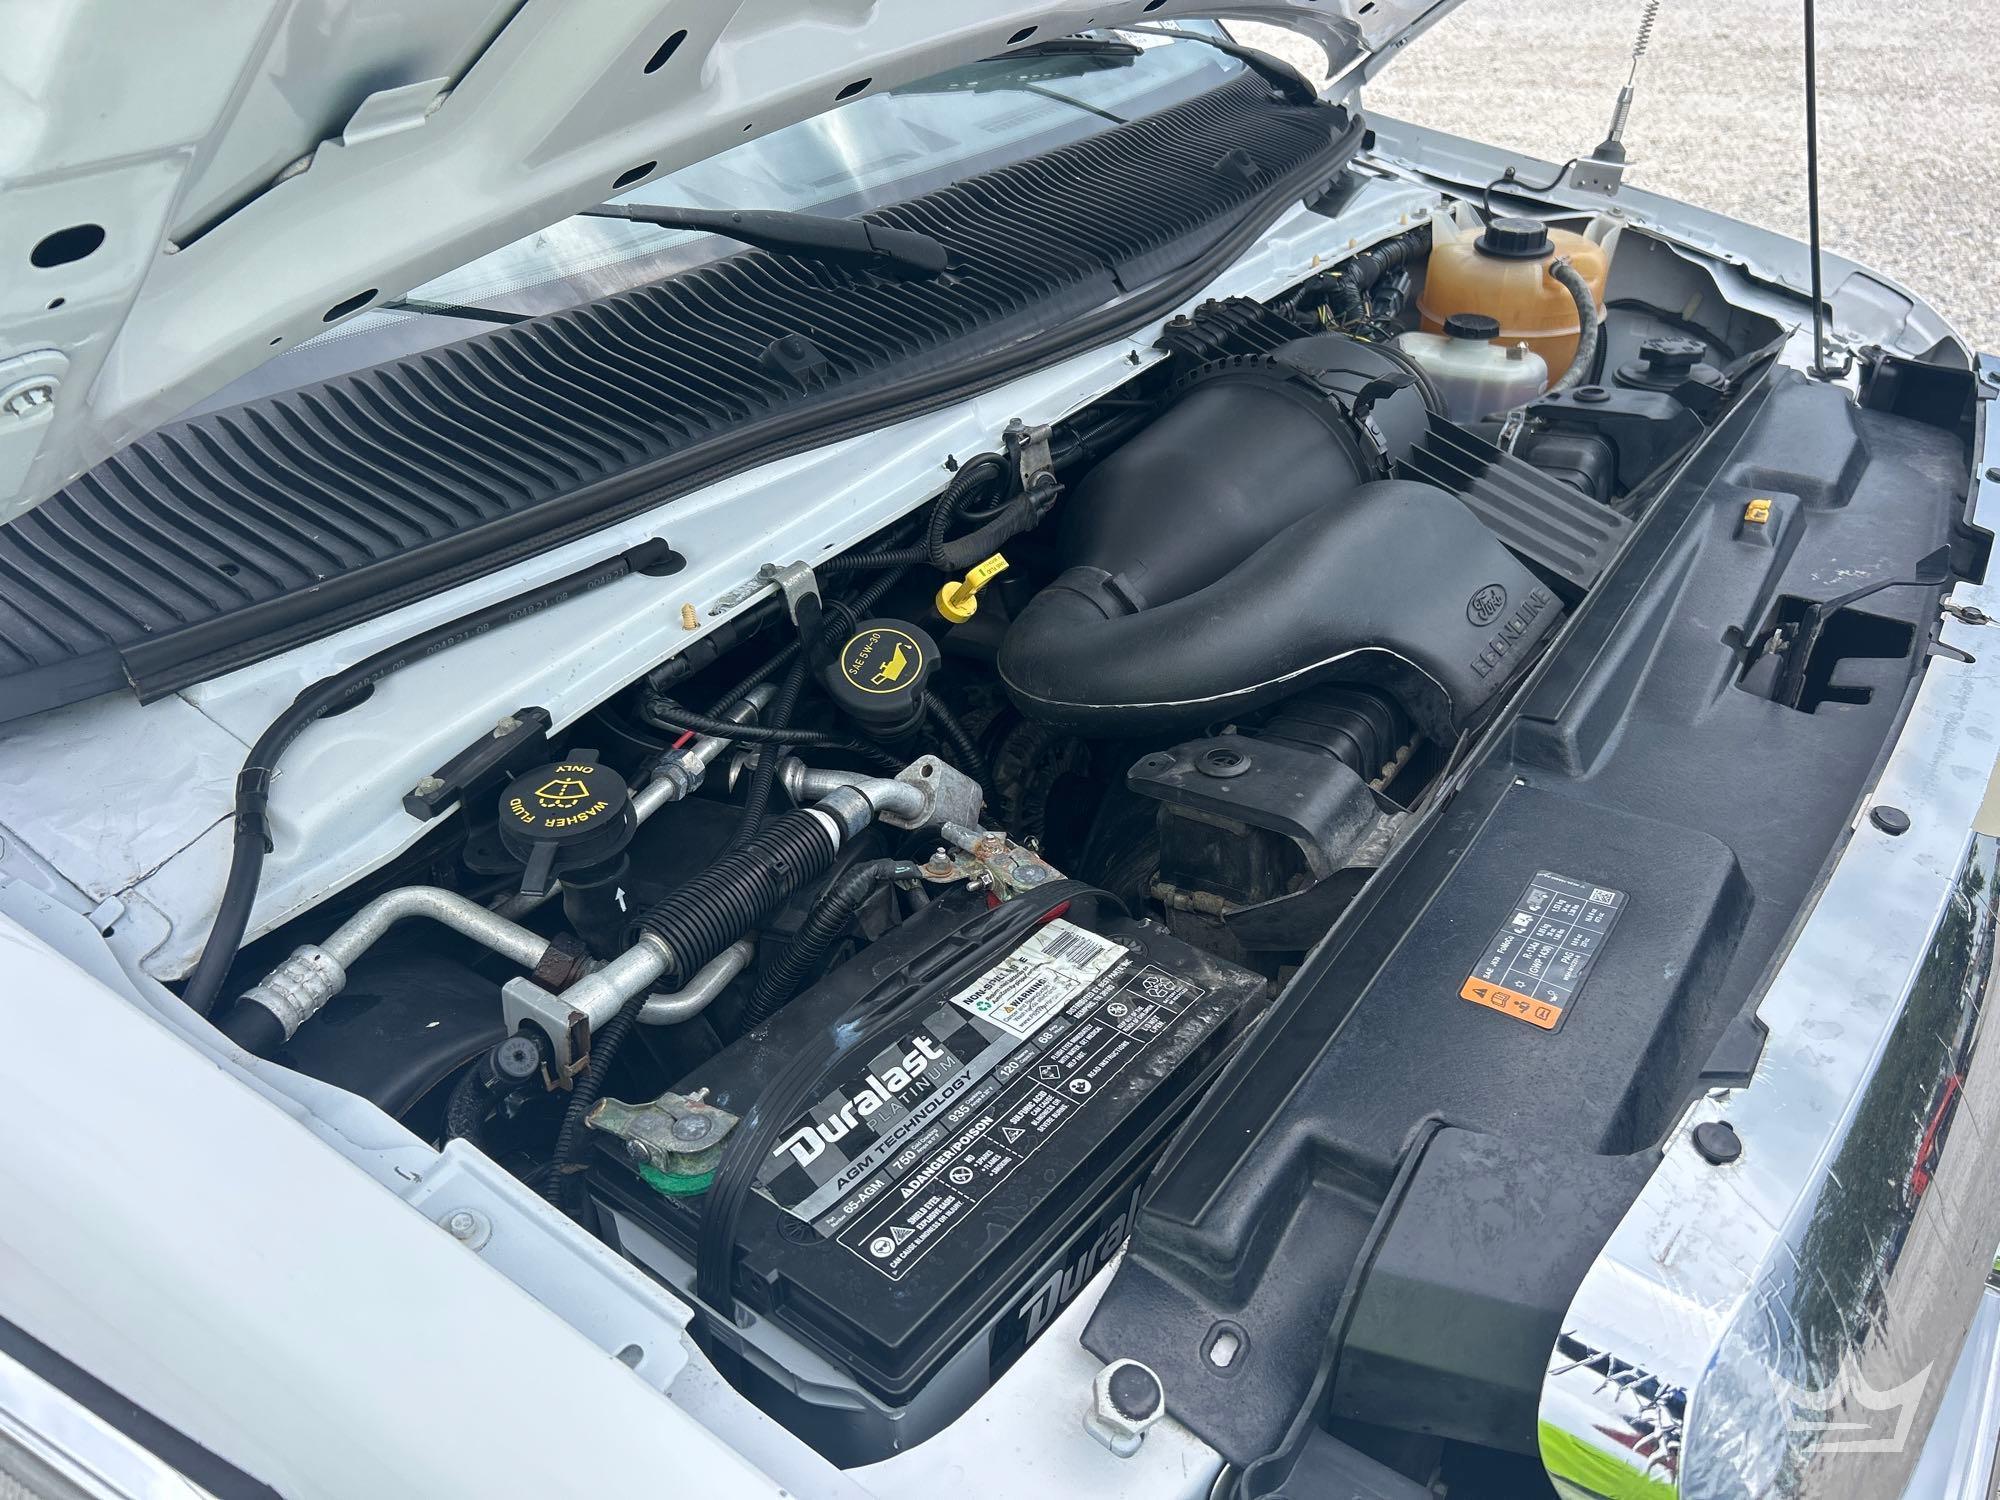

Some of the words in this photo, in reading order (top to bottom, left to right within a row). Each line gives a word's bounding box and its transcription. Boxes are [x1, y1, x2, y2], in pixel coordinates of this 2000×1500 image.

[1473, 590, 1503, 620] Ford
[1470, 588, 1551, 678] ECONOLINE
[849, 659, 865, 675] SAE
[861, 633, 881, 660] 5W-30
[555, 765, 594, 775] ONLY
[509, 798, 536, 824] FLUID
[545, 801, 610, 827] WASHER
[1481, 967, 1494, 979] SAE
[1496, 934, 1514, 954] FoMoCo
[1522, 941, 1539, 959] R-134a
[1560, 951, 1574, 964] PAG
[1527, 958, 1546, 976] (GWP
[962, 956, 1028, 1004] NON-SPILLABE
[1065, 991, 1095, 1015] DISTRIBUTED
[1096, 977, 1111, 988] BEST
[1047, 1023, 1058, 1031] Amp
[1116, 1020, 1127, 1029] KEEP
[1121, 1021, 1135, 1032] REACH
[1147, 1014, 1161, 1025] NOT
[1036, 1031, 1054, 1044] 68
[1049, 1048, 1065, 1060] FLUSH
[1060, 1041, 1073, 1050] EYES
[1069, 1023, 1094, 1043] IMMEDIATELY
[1057, 1054, 1070, 1064] WITH
[1078, 1037, 1089, 1045] GET
[1084, 1025, 1103, 1040] MEDICAL
[1013, 1048, 1029, 1061] Reserve
[1018, 1050, 1035, 1064] Capacity
[1065, 1058, 1078, 1068] HELP
[998, 1060, 1020, 1077] 120
[1086, 1065, 1102, 1078] READ
[770, 1034, 946, 1167] Duralast
[865, 1055, 958, 1132] PLATINUM
[964, 1090, 982, 1104] Cranking
[969, 1097, 982, 1107] Amps
[947, 1104, 971, 1122] 935
[1008, 1101, 1036, 1124] SULFURIC
[1031, 1090, 1048, 1103] ACID
[1029, 1106, 1042, 1116] CAN
[1037, 1094, 1055, 1108] CAUSE
[1030, 1103, 1056, 1126] BLINDNESS
[1036, 1116, 1056, 1132] SEVERE
[1050, 1102, 1070, 1118] BURNS.
[840, 1154, 875, 1190] AGM
[873, 1069, 970, 1154] TECHNOLOGY
[910, 1140, 922, 1149] Cold
[919, 1127, 938, 1143] Cranking
[907, 1115, 994, 1190] DANGER/POISON
[916, 1142, 929, 1153] Amps
[974, 1149, 994, 1165] SPARKS
[891, 1149, 918, 1170] 750
[963, 1153, 976, 1163] NO
[982, 1153, 1002, 1169] FLAMES
[991, 1156, 1013, 1174] SMOKING
[841, 1178, 885, 1214] 65-AGM
[825, 1215, 836, 1224] Part
[831, 1214, 847, 1227] Number
[906, 1206, 928, 1225] SHIELD
[915, 1207, 942, 1230] EXPLOSIVE
[937, 1194, 956, 1210] GASES
[888, 1256, 902, 1268] CAN
[898, 1242, 918, 1259] CAUSE
[913, 1220, 941, 1245] BLINDNESS
[937, 1214, 948, 1223] OR
[944, 1199, 965, 1216] INJURY.
[1018, 1183, 1141, 1344] Dural
